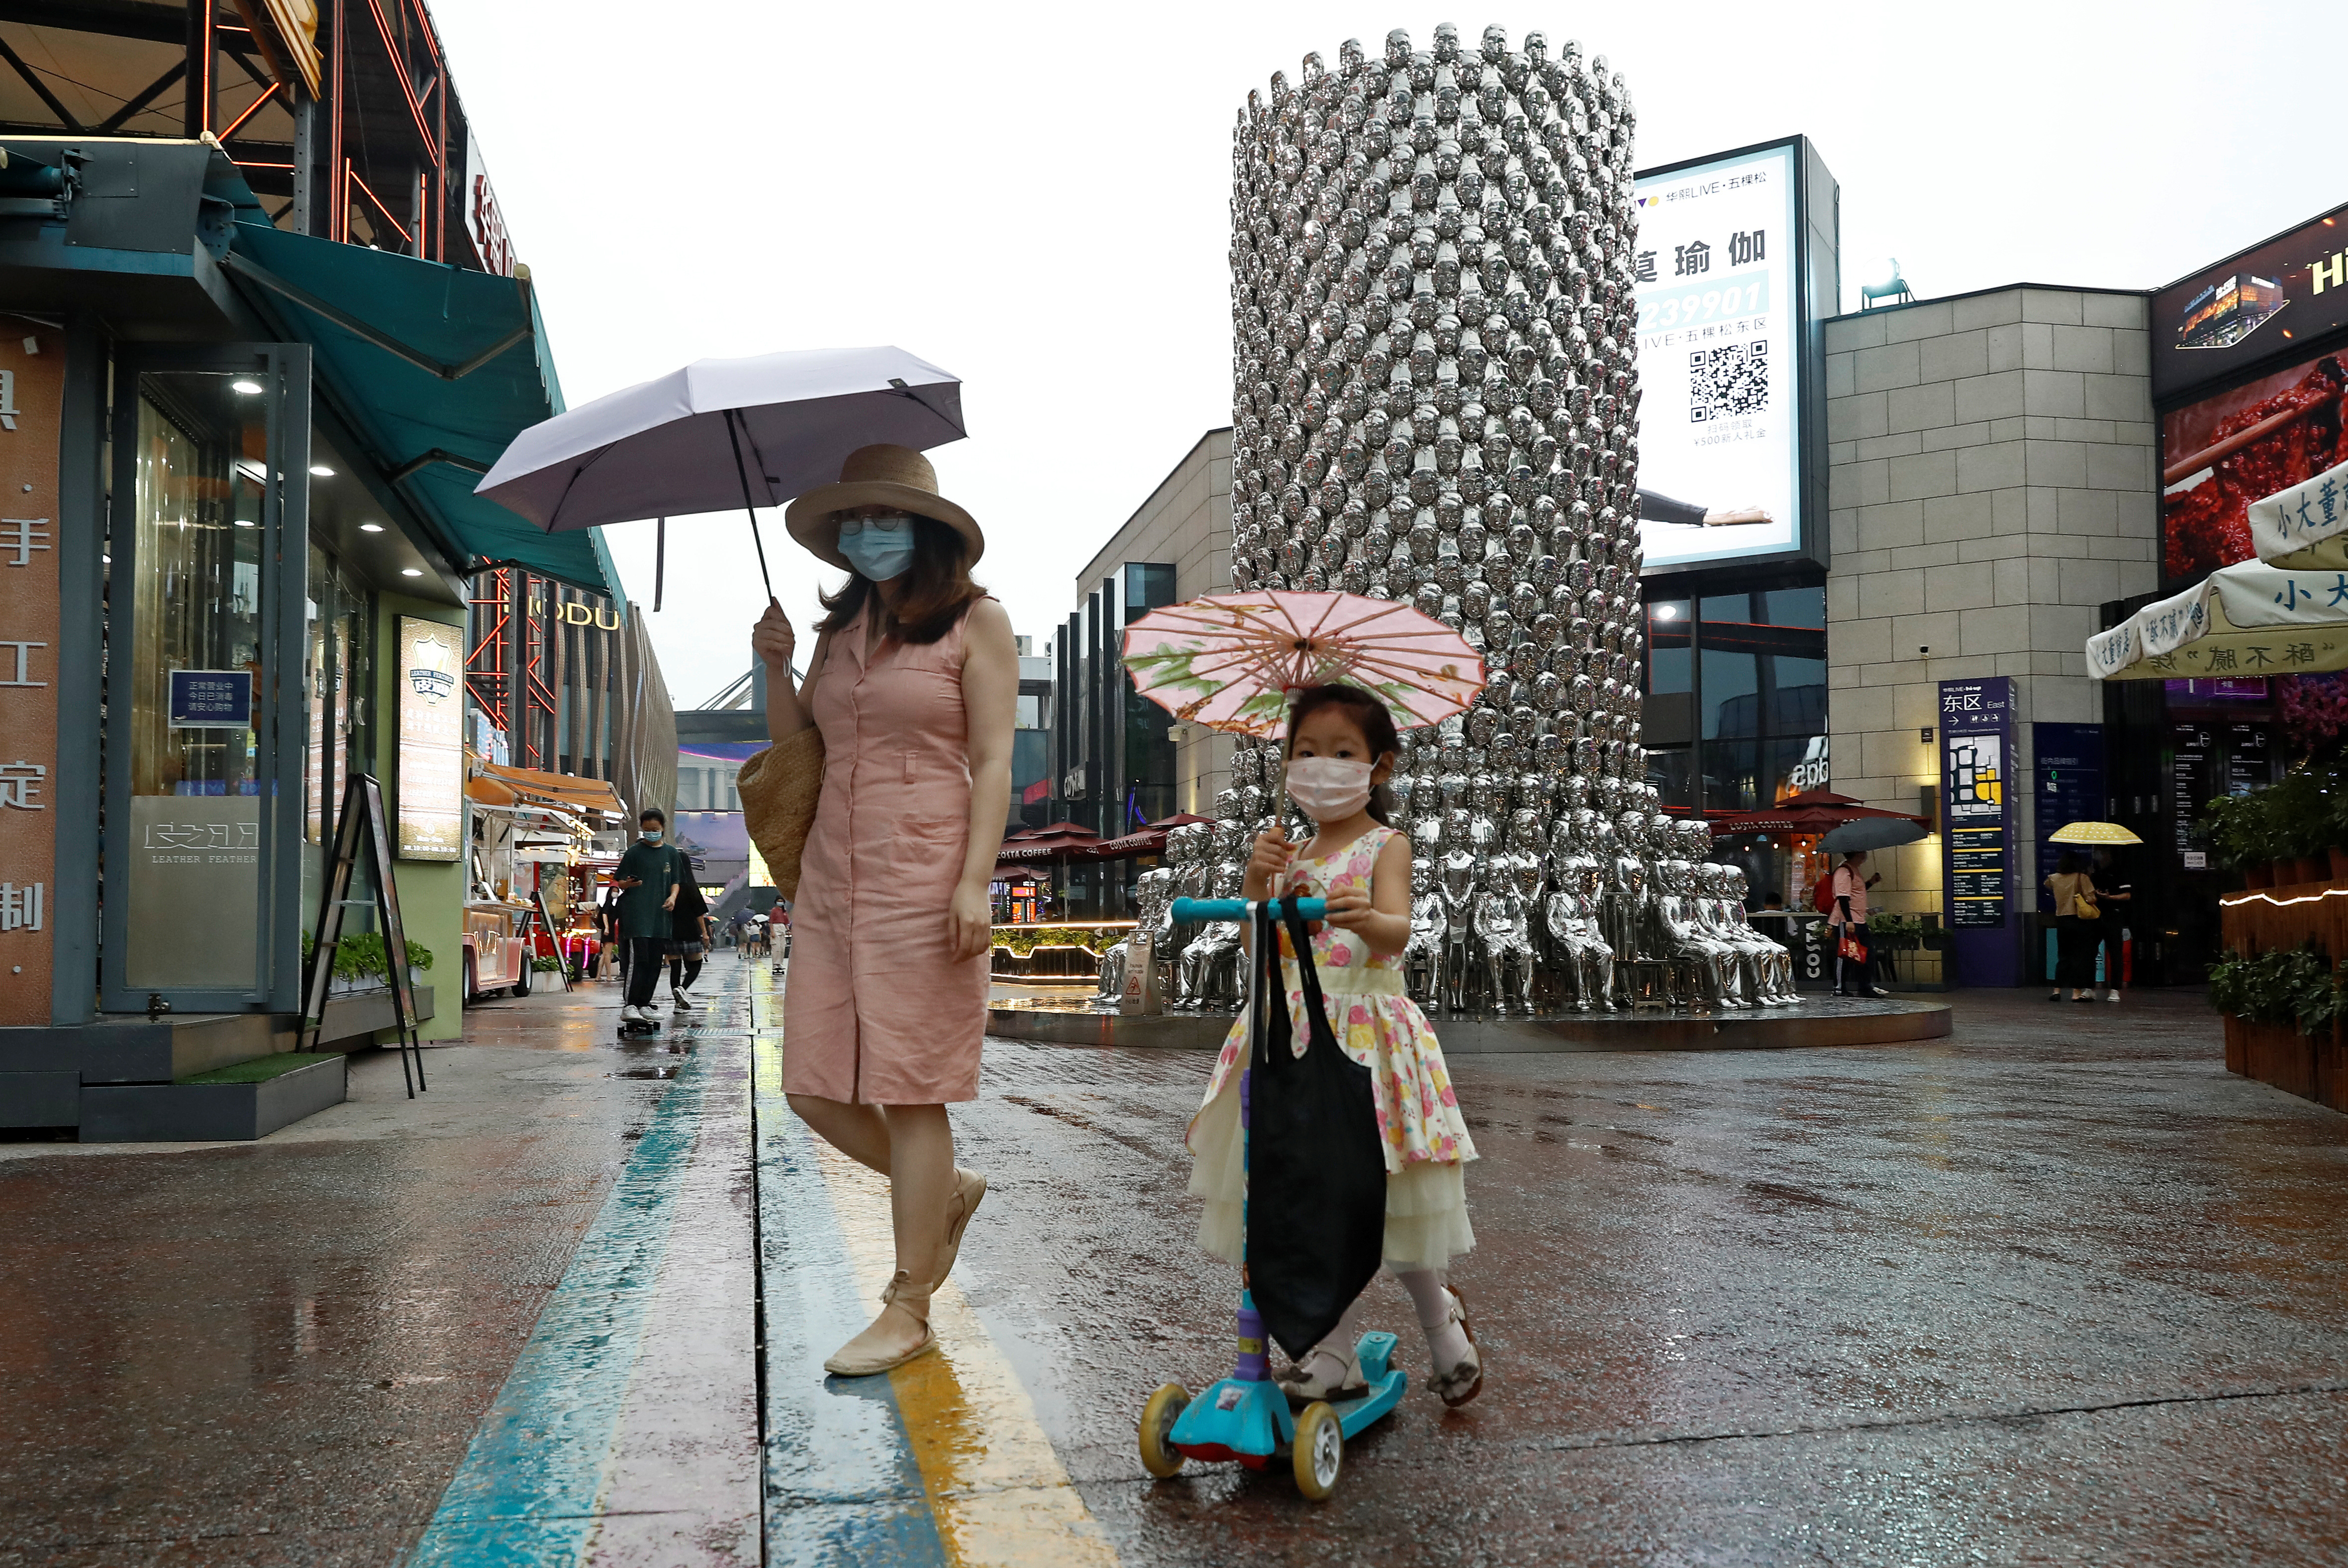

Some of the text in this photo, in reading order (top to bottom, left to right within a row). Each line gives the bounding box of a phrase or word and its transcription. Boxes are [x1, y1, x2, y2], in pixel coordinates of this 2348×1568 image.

[1666, 171, 1766, 202] 华熙LIVE·五棵松
[1638, 282, 1761, 331] 239901
[1638, 317, 1766, 351] IVE·五棵松东区
[1708, 419, 1753, 434] 扫码领取
[2278, 474, 2348, 540] 小大董
[189, 682, 233, 690] 正常营业中
[188, 691, 233, 701] 今日已消毒
[1943, 693, 1982, 712] 东区
[188, 702, 233, 711] 请安心购物
[1729, 821, 1794, 831] COSTA COFFEE
[1109, 838, 1152, 850] COSTA COFFEE
[997, 848, 1052, 859] COSTA COFFEE
[1806, 920, 1821, 978] COSTA
